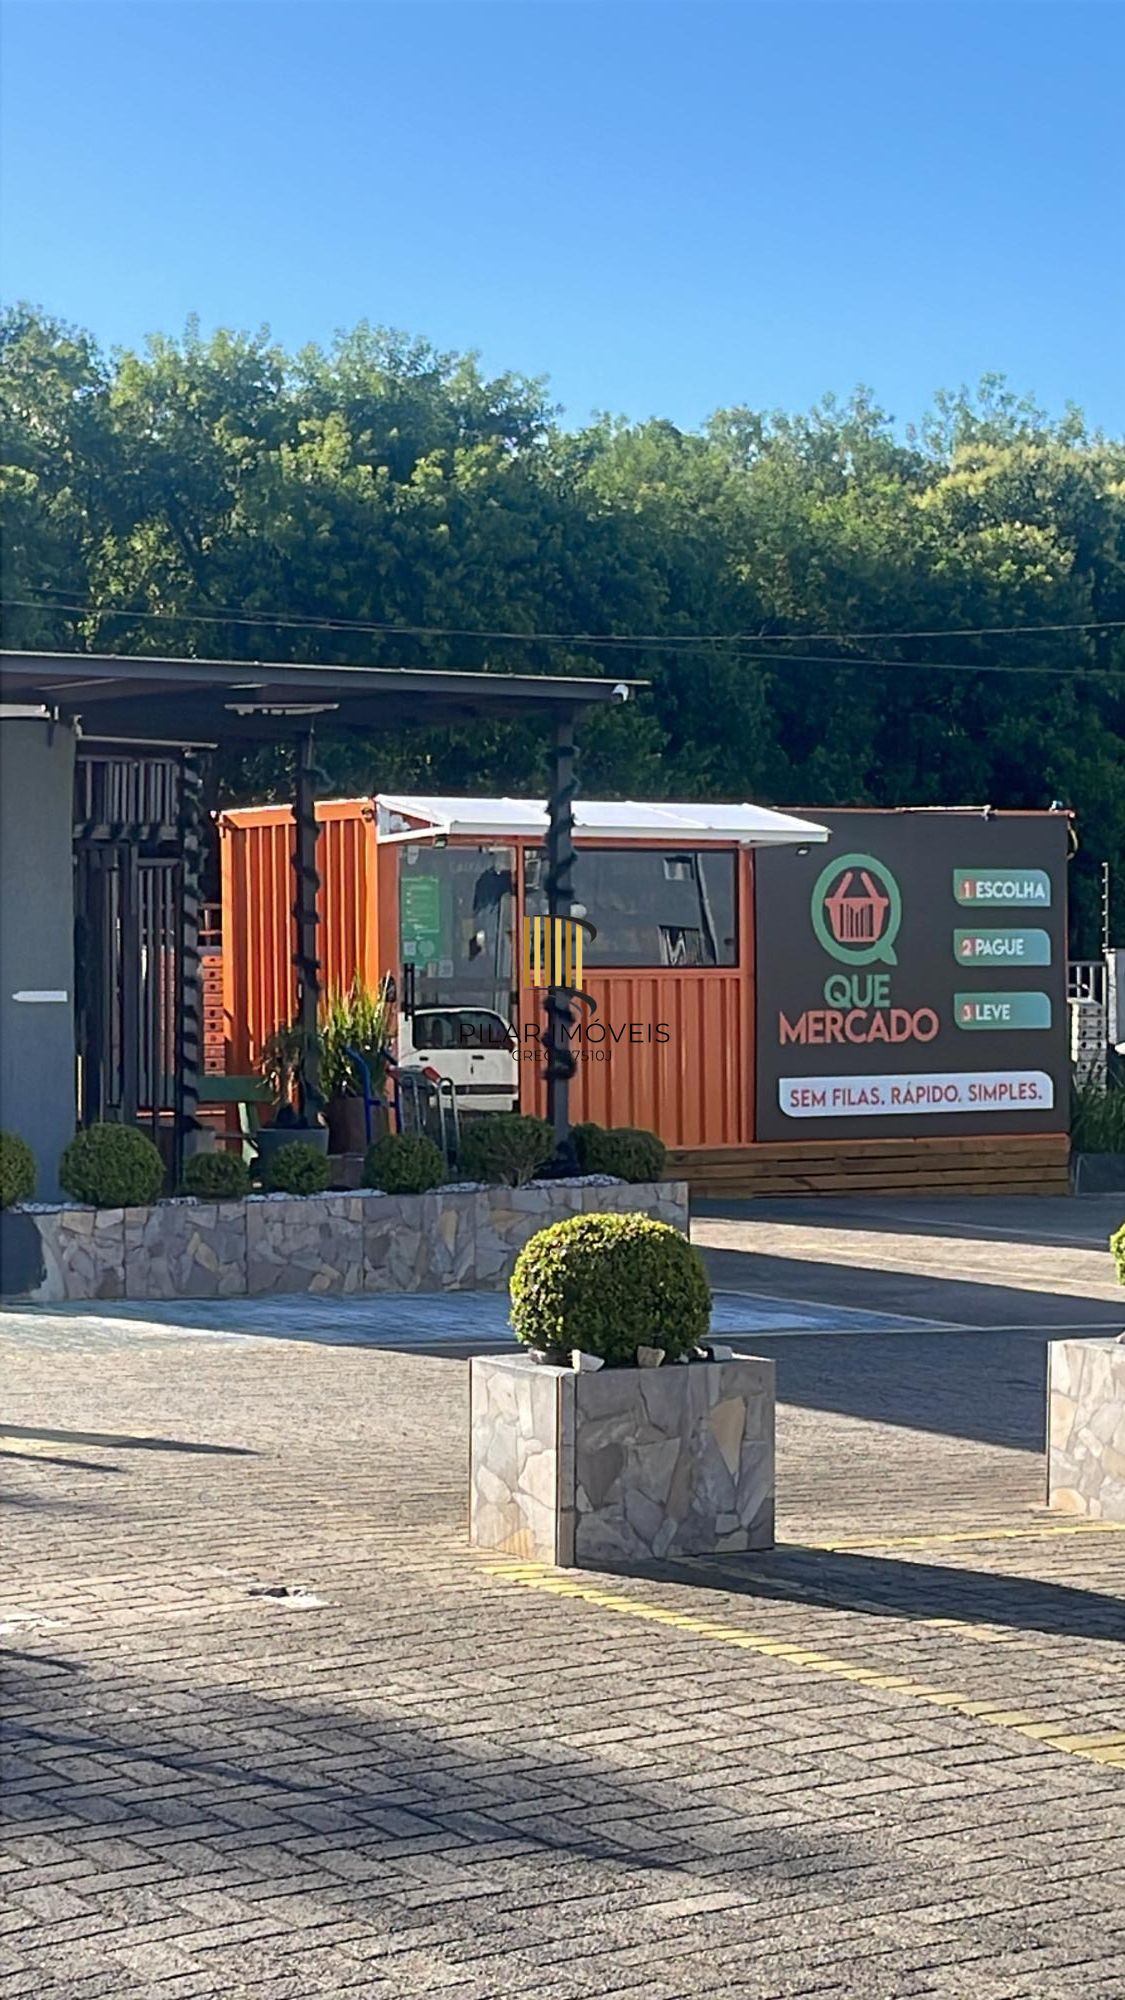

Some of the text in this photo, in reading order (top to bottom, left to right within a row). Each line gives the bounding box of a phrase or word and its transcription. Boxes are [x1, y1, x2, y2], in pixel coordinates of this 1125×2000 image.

[975, 880, 1045, 899] ESCOLHA
[975, 938, 1024, 956] PAGUE
[823, 974, 891, 1008] QUE
[975, 1004, 1010, 1021] LEVE
[779, 1008, 940, 1045] MERCADO
[789, 1082, 1043, 1108] SEM FILAS. RÁPIDO. SIMPLES.
